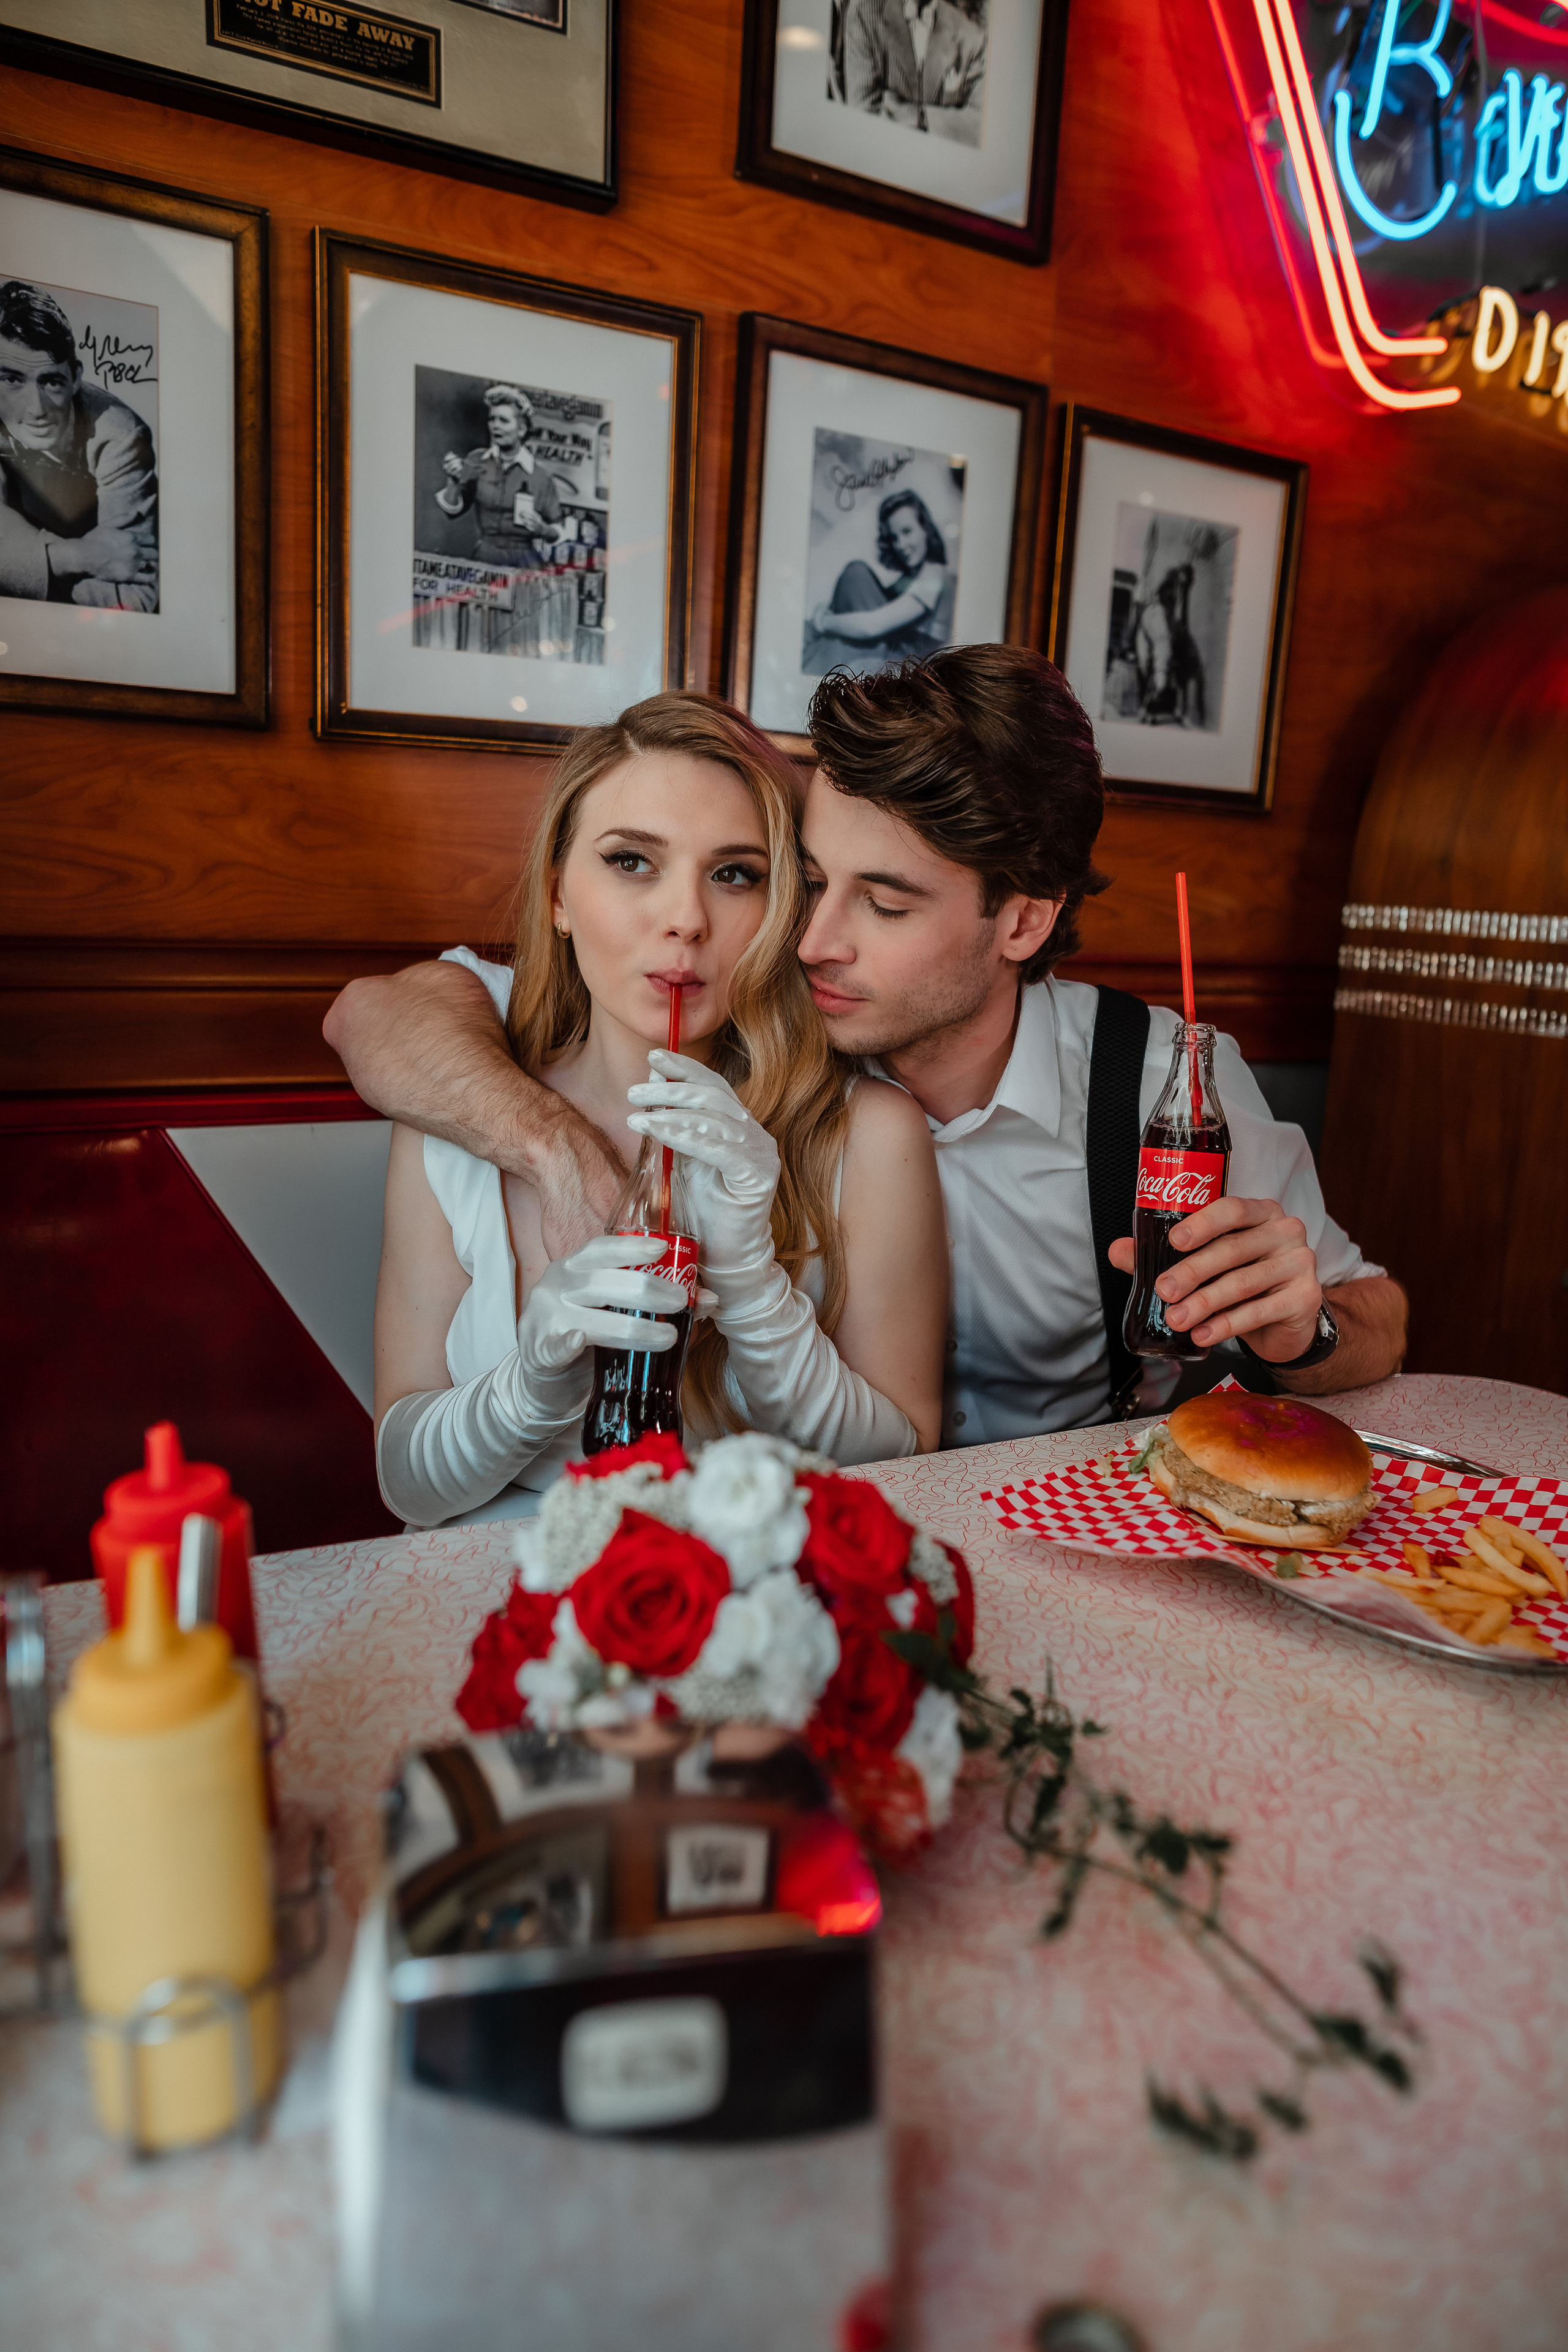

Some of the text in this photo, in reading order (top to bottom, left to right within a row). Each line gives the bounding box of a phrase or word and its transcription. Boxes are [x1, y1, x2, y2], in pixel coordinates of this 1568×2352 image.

[292, 1, 348, 32] FADE
[357, 21, 415, 51] AWAY
[1153, 1155, 1184, 1164] CLASSIC
[1136, 1167, 1216, 1205] Coca-Cola
[669, 1243, 692, 1254] LASSIC
